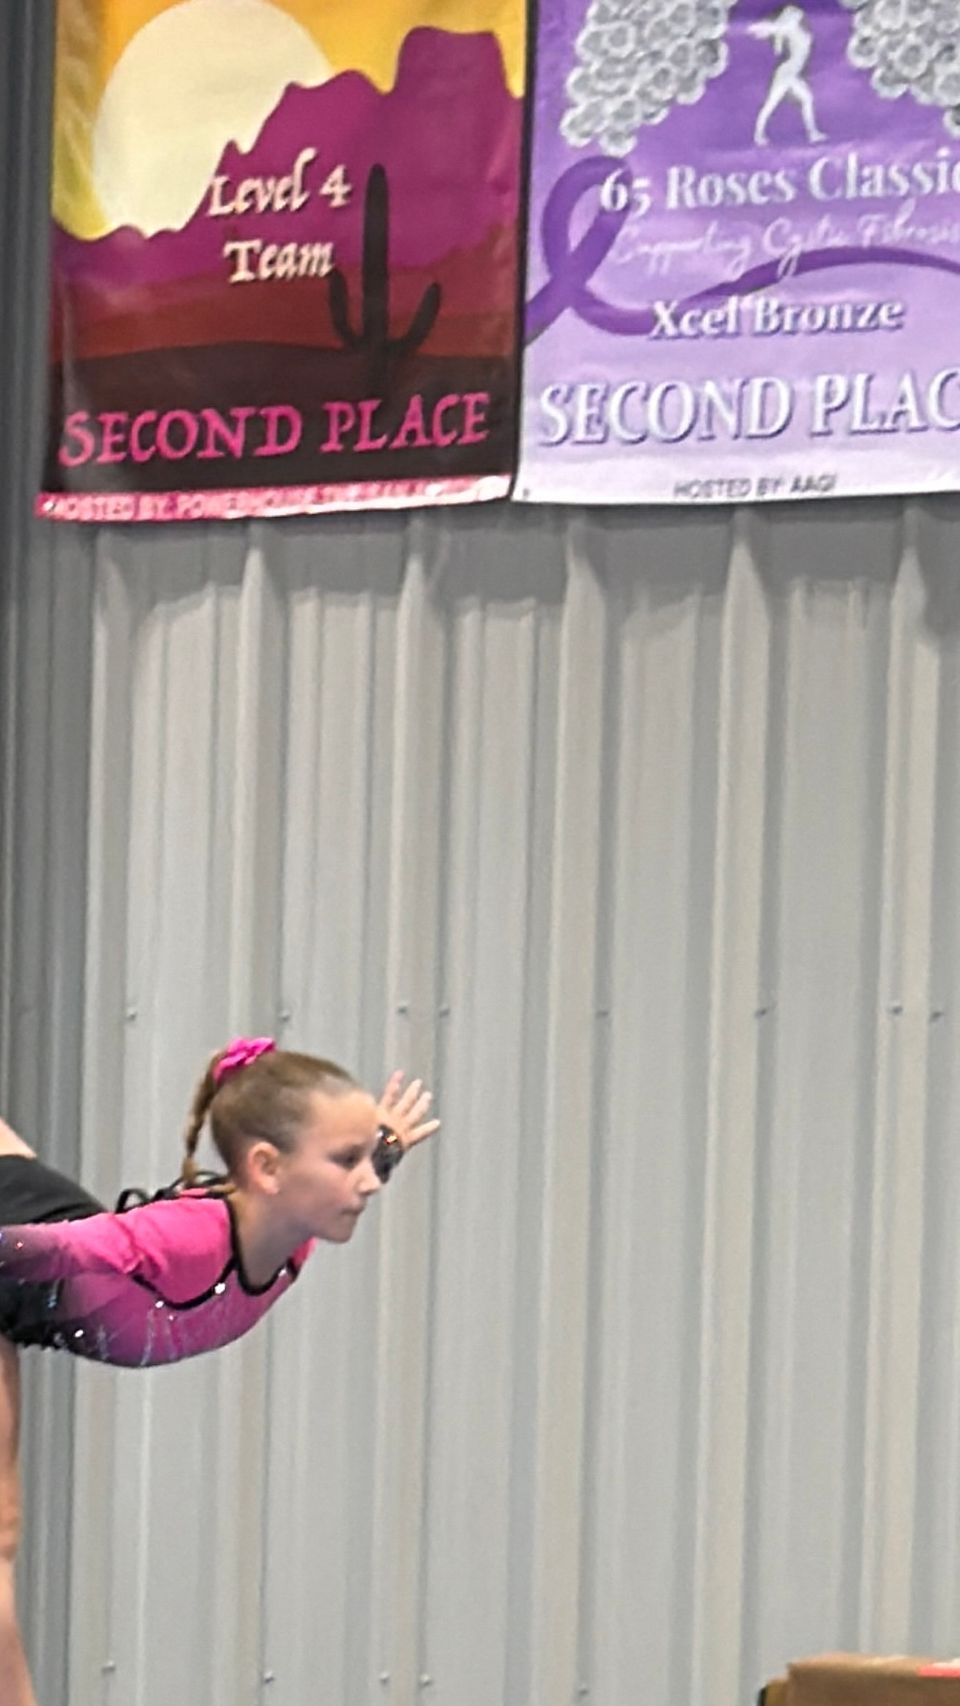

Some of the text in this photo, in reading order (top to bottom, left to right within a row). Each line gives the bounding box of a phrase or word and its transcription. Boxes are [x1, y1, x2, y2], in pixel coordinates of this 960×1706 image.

[208, 147, 352, 217] Level 4
[599, 168, 651, 217] 65
[666, 163, 796, 210] Roses
[222, 240, 335, 284] Team
[648, 294, 904, 341] Xcel Bronze
[58, 392, 491, 468] SECOND PLACE
[540, 368, 960, 447] SECOND PLAC
[674, 478, 751, 499] HOSTED
